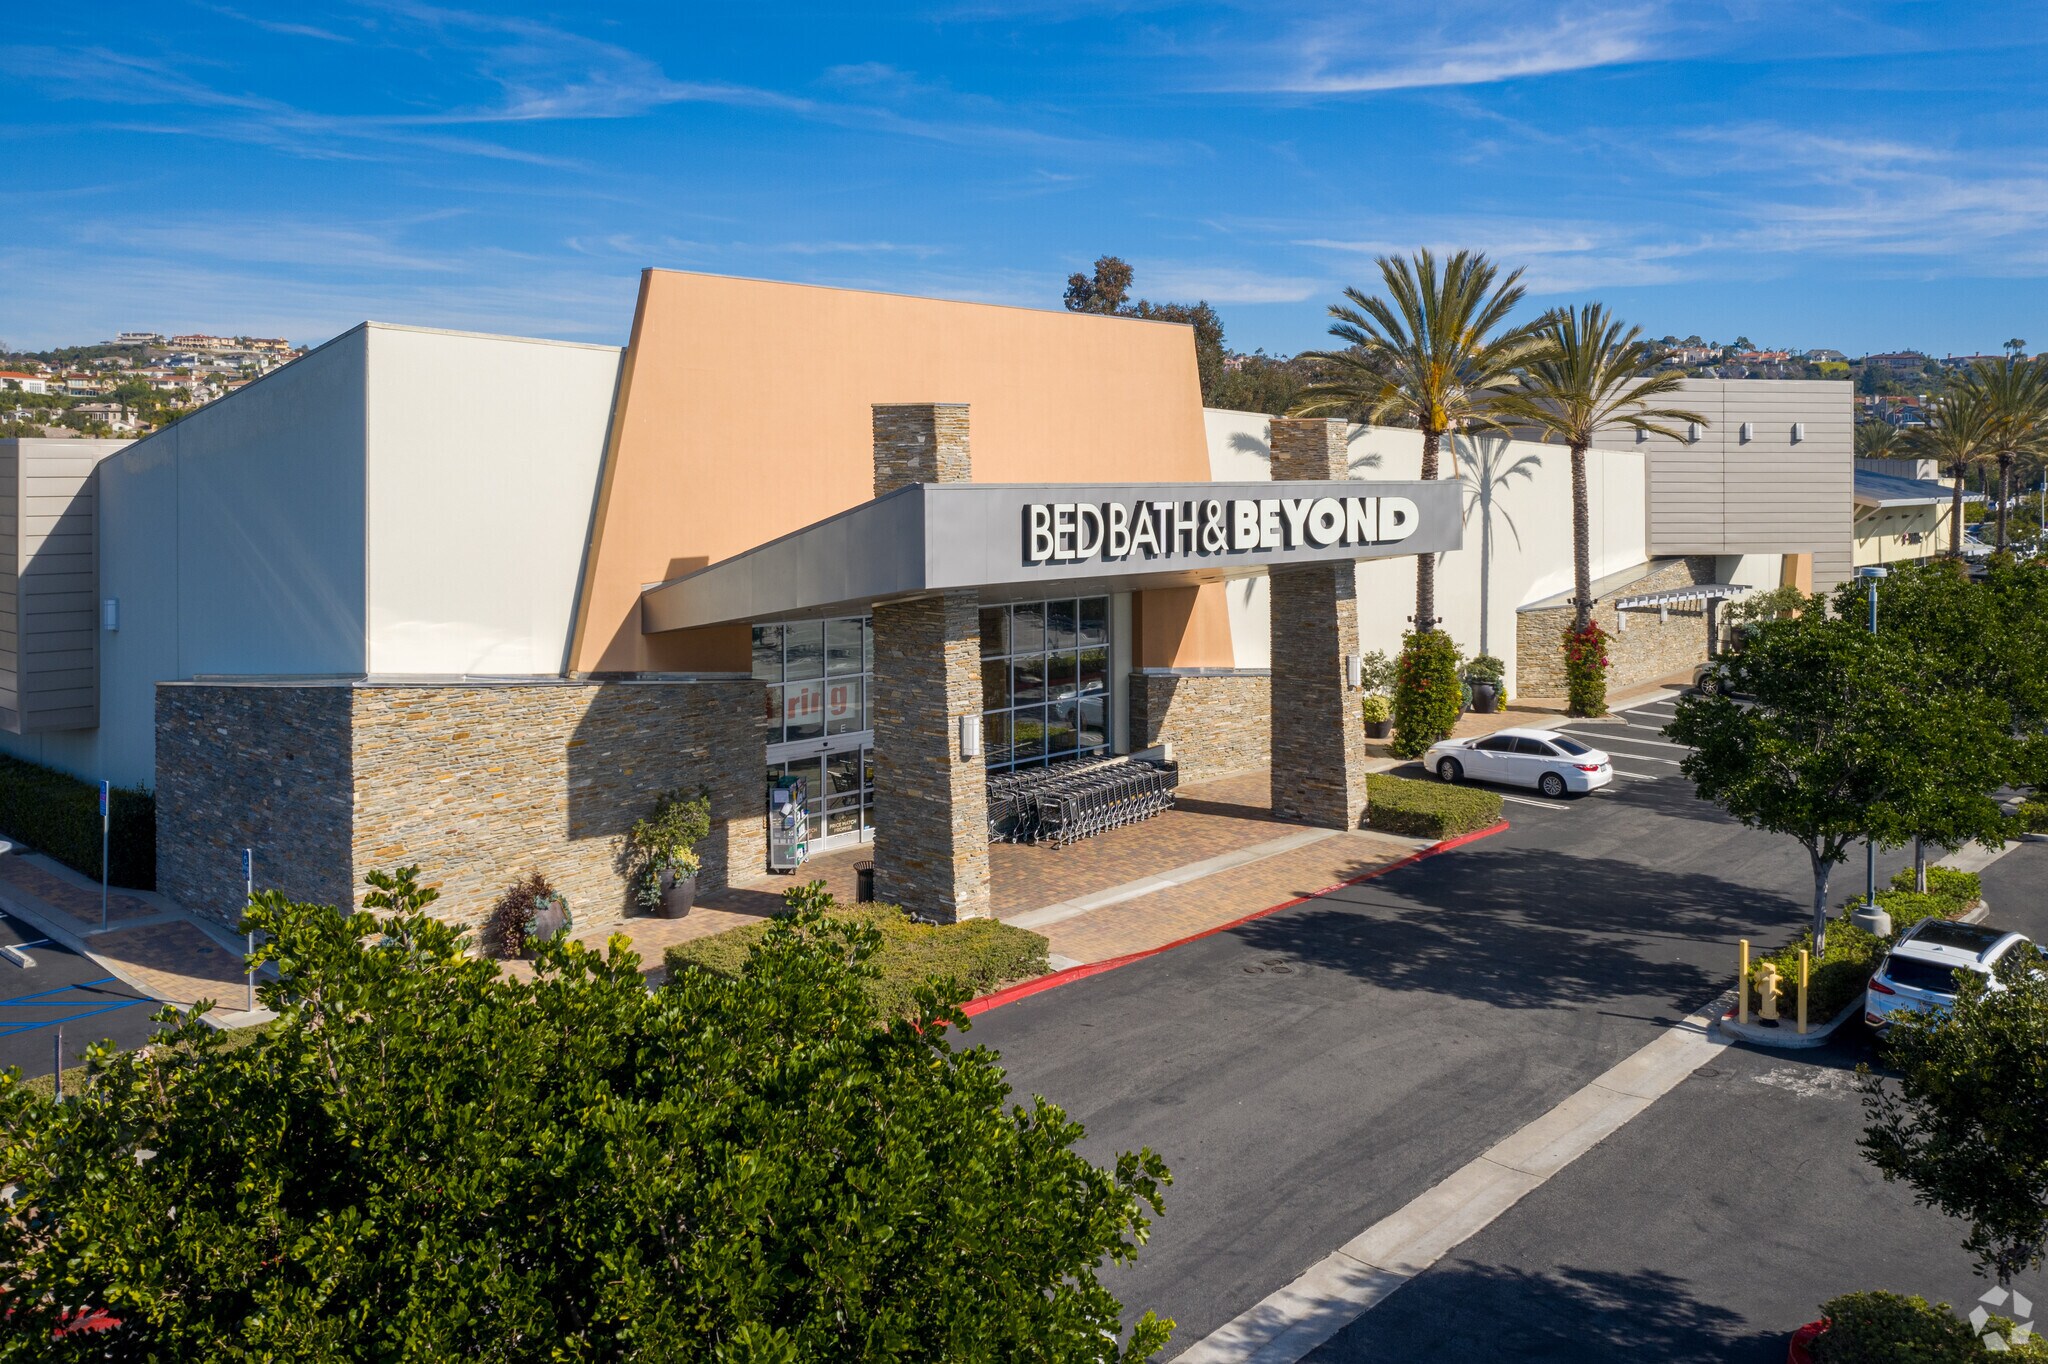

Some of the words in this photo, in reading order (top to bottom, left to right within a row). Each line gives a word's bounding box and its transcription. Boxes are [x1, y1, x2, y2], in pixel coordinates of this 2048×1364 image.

[1029, 503, 1105, 562] BED
[1108, 500, 1198, 558] BATH
[1201, 499, 1230, 552] &
[1233, 497, 1420, 550] BEYOND
